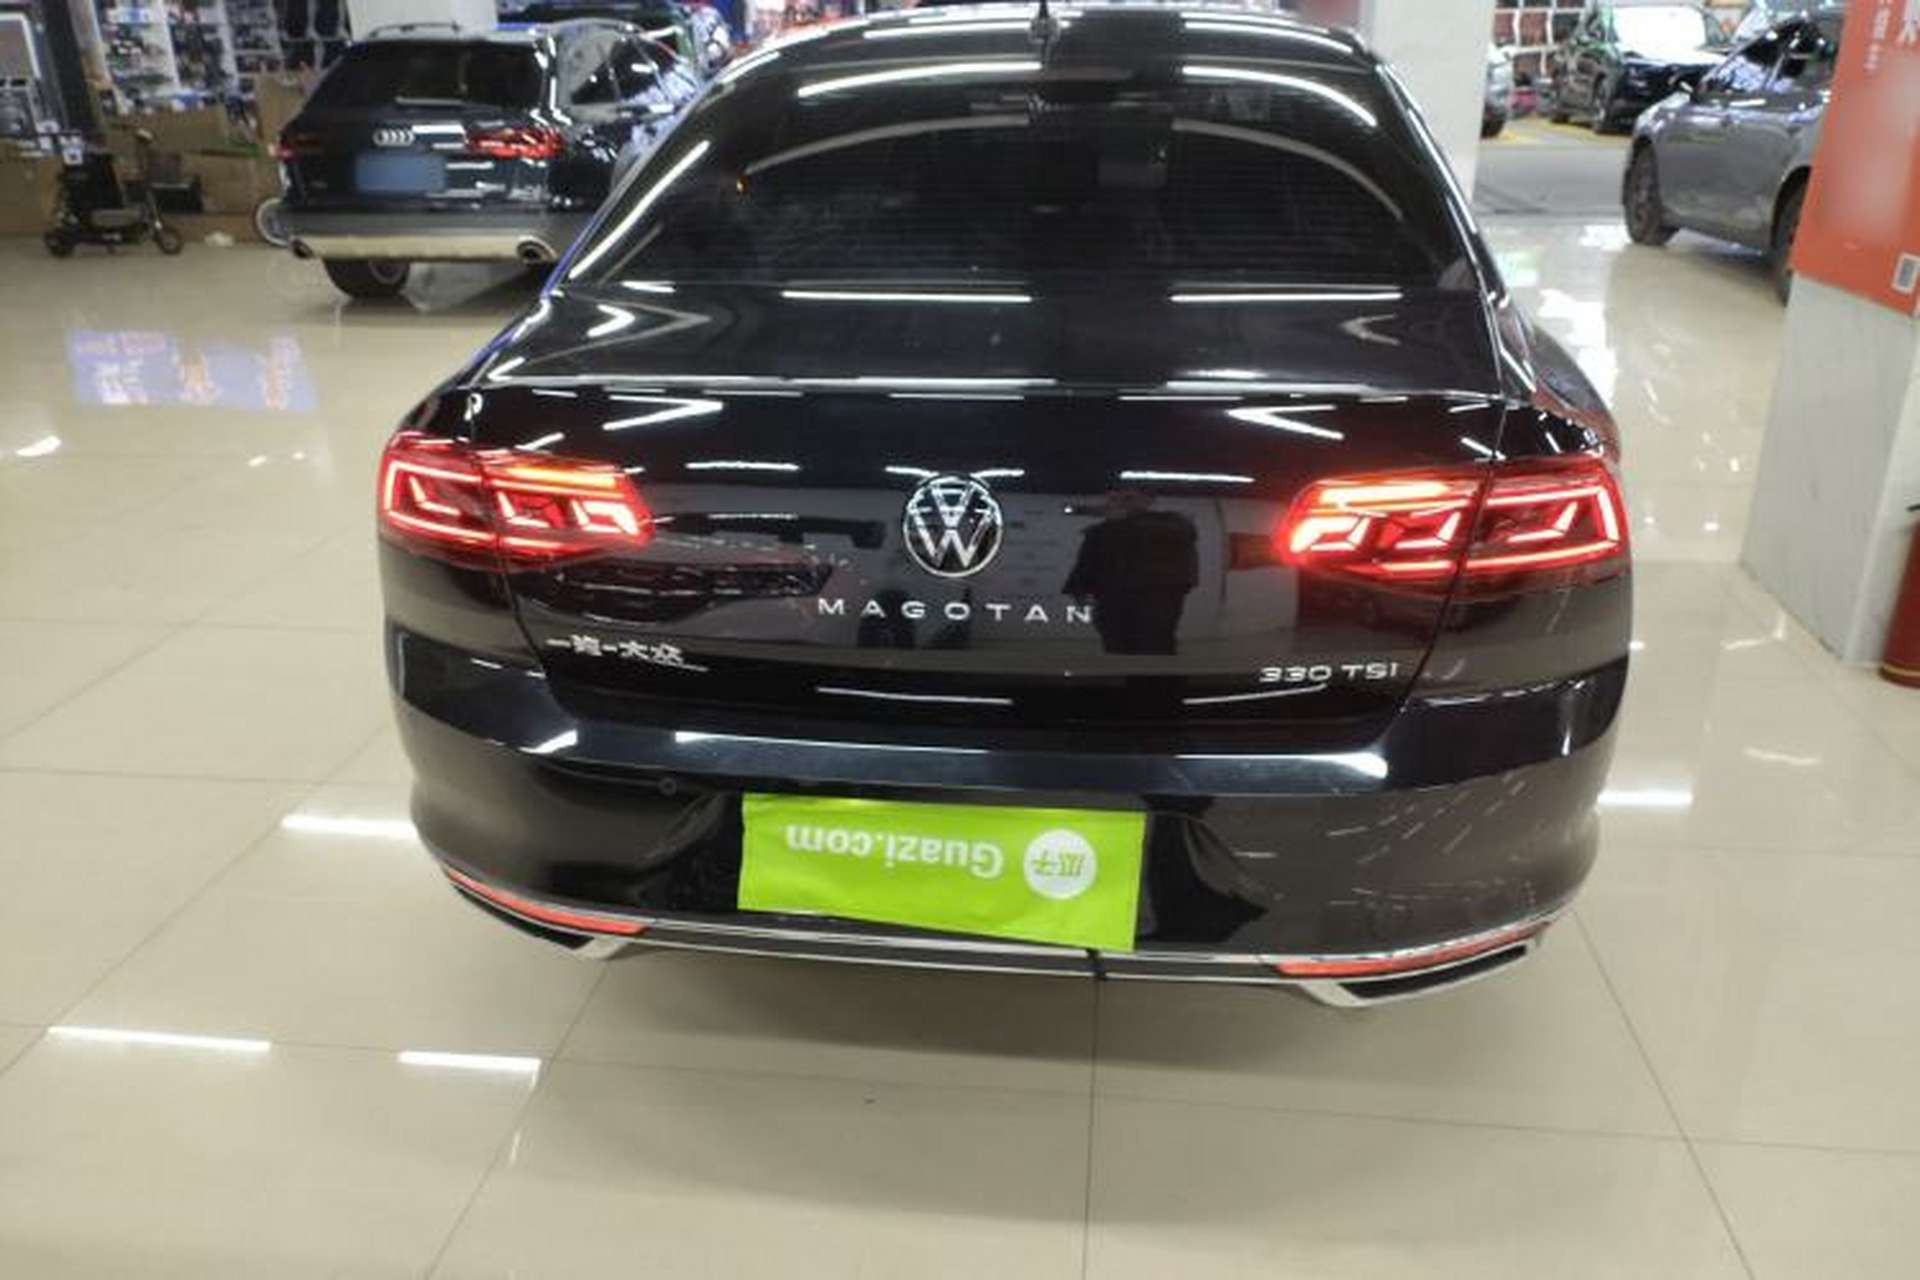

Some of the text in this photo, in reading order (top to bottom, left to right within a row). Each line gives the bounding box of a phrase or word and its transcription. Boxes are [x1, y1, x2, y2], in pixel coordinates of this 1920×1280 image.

[817, 597, 1093, 624] MAGOTAN
[1259, 661, 1399, 683] 330 TSI
[785, 823, 1005, 880] Guazi.com
